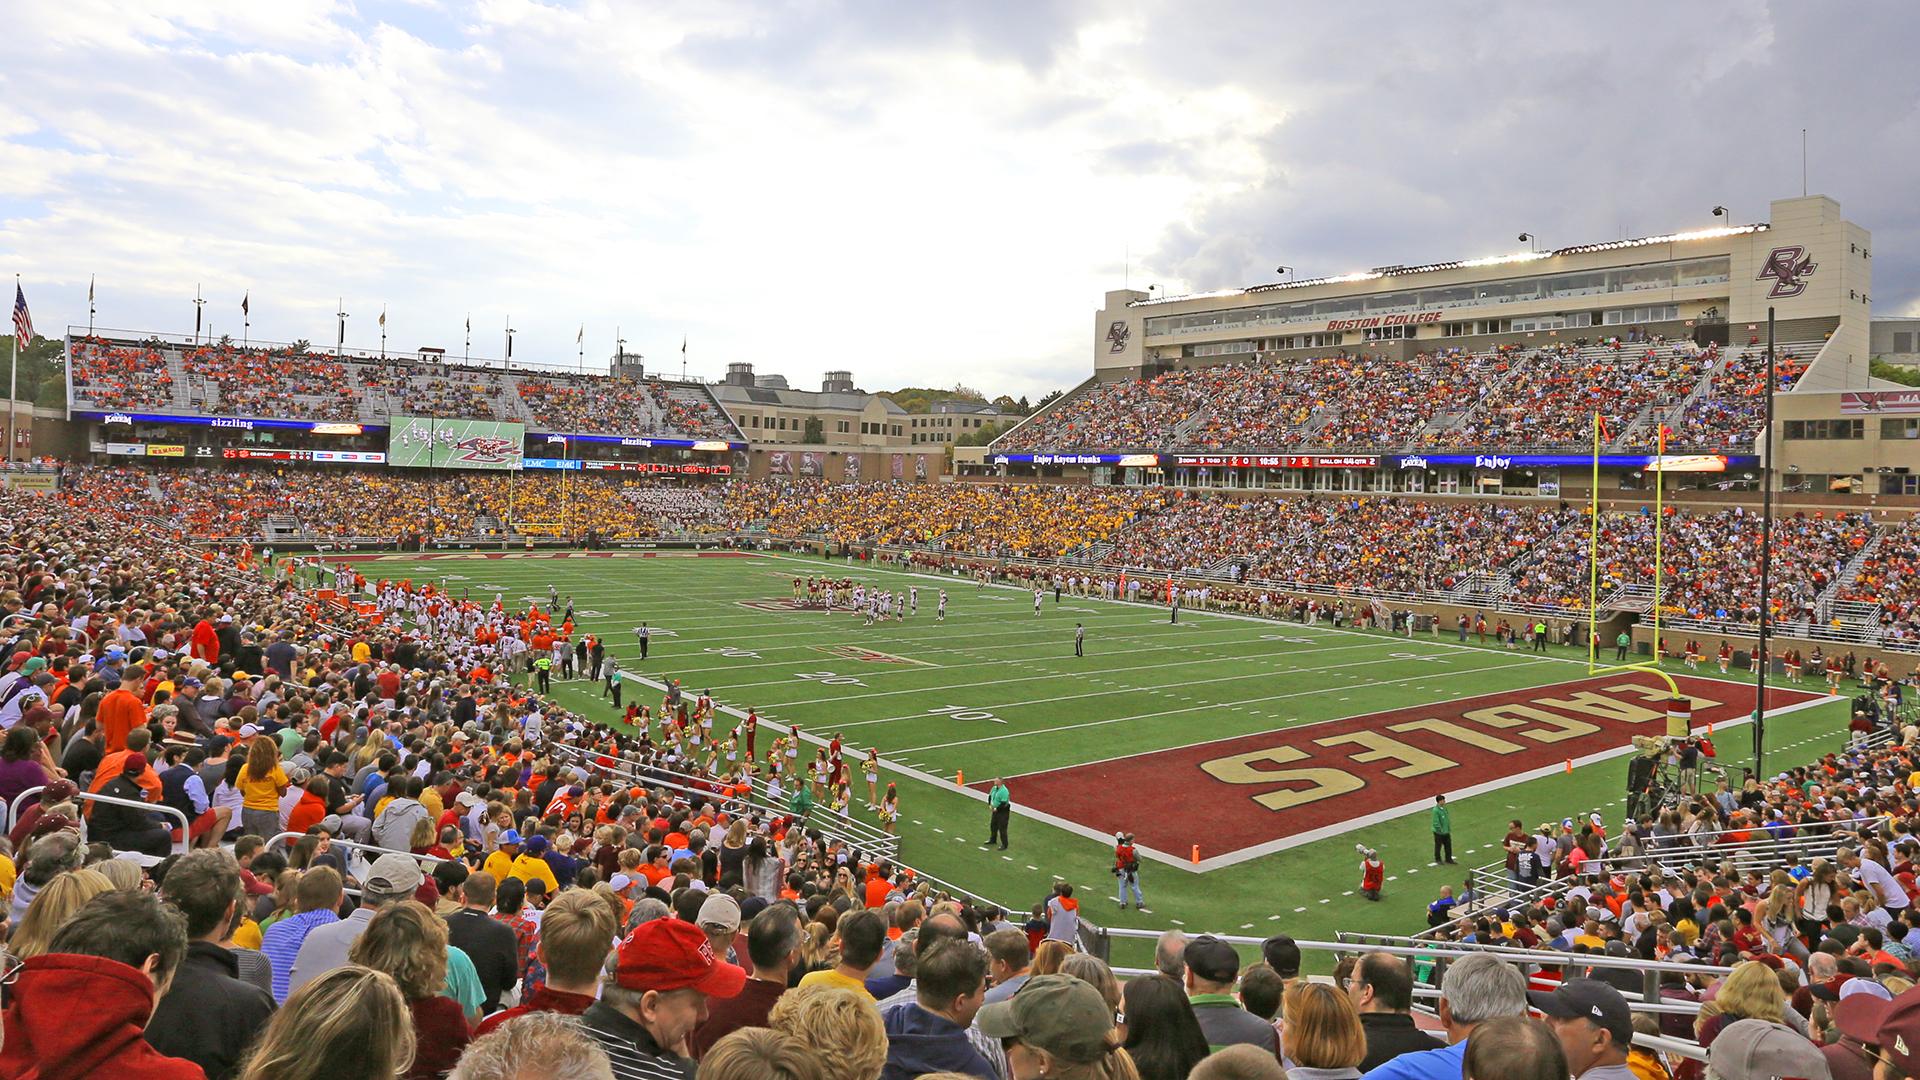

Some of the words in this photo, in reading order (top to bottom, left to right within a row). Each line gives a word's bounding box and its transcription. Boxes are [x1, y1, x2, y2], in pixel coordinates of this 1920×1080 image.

[1327, 317, 1380, 331] BOSTON
[1384, 312, 1443, 326] COLLEGE
[211, 418, 253, 429] sizzling
[621, 438, 652, 447] sizzling
[223, 450, 236, 459] 25
[1033, 455, 1053, 465] Enjoy
[1054, 455, 1077, 465] Kayem
[1078, 455, 1101, 464] franks
[1259, 457, 1279, 465] 10:55
[1400, 459, 1427, 469] KAYEM
[1475, 455, 1511, 469] Enjoy
[927, 704, 994, 721] 10
[1200, 684, 1724, 811] EAGLES
